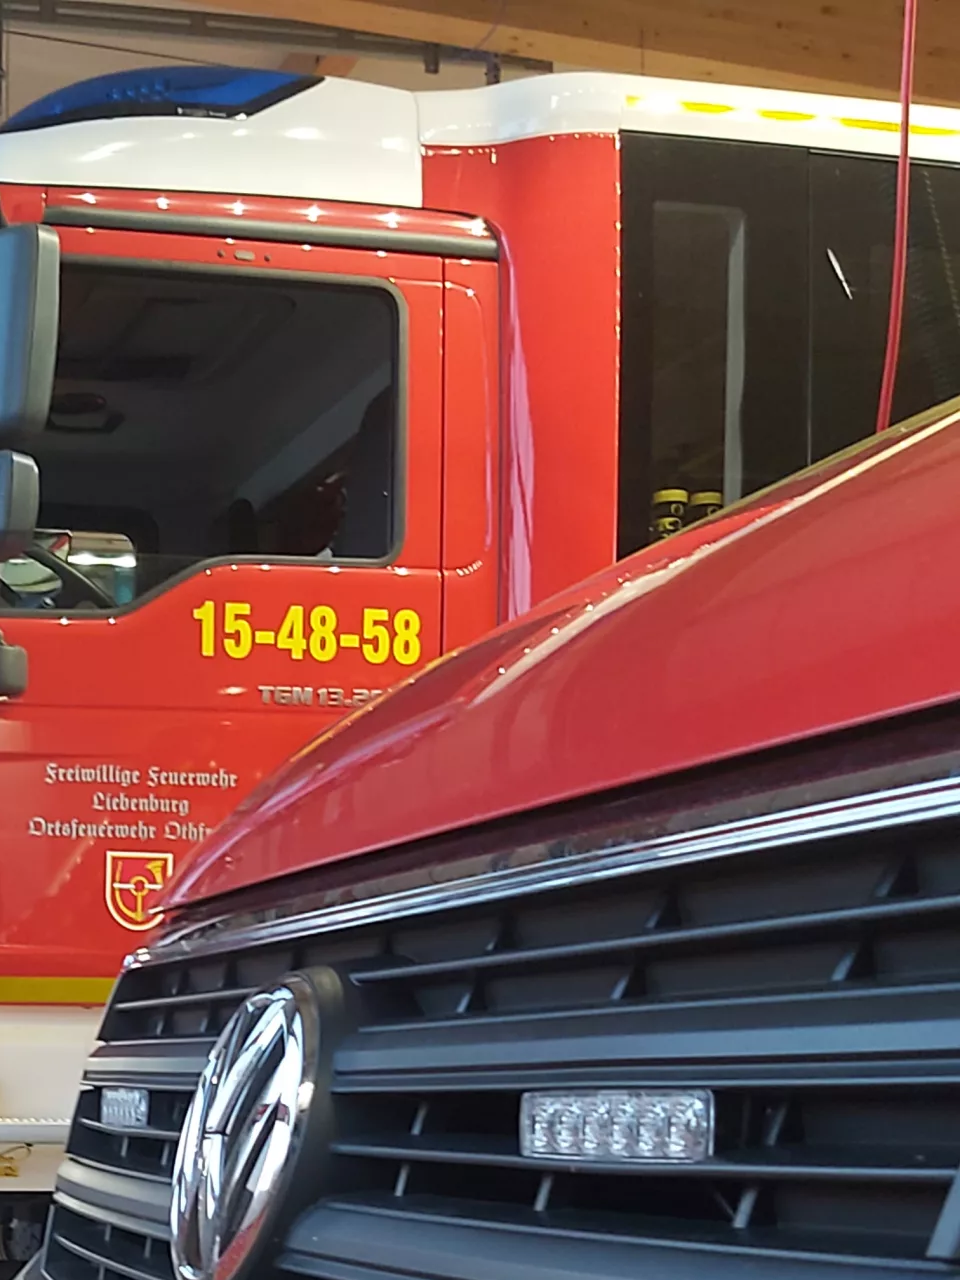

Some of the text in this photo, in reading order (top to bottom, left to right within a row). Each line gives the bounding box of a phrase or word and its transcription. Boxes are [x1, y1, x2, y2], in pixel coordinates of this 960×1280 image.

[193, 601, 422, 665] 15-48-58
[258, 686, 313, 704] TGM
[44, 763, 238, 788] Freiwillige Feuerwehr
[92, 792, 189, 815] Liebenburg
[29, 817, 156, 840] Ortsfeuerwehr
